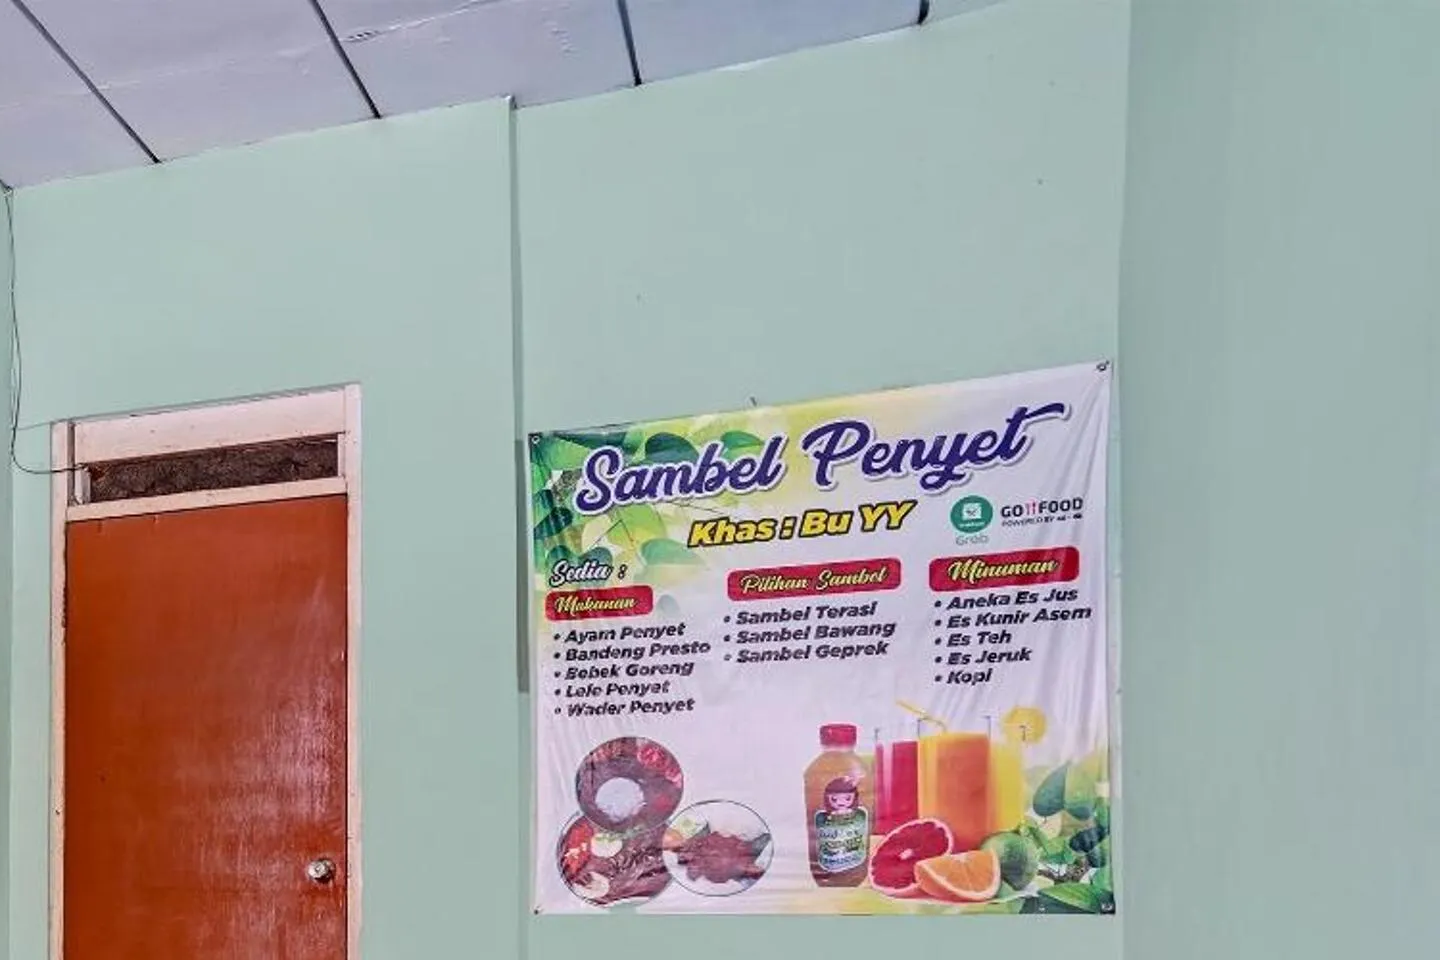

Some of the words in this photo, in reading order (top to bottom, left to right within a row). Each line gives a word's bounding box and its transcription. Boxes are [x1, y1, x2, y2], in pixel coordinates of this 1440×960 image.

[575, 434, 784, 513] Sambel
[800, 402, 1066, 491] Penyet
[687, 517, 775, 548] Khas
[799, 508, 853, 537] Bu
[858, 499, 918, 530] YY
[549, 560, 612, 587] Sedia
[740, 574, 809, 594] Pilihan
[816, 566, 889, 590] Sambel
[948, 559, 1057, 585] Minuman
[554, 595, 636, 616] Makanan
[946, 593, 1011, 610] Aneka
[1014, 591, 1039, 605] Es
[1043, 588, 1079, 602] Jus
[736, 606, 811, 625] Sambel
[816, 601, 878, 619] Terasi
[946, 615, 972, 629] Es
[974, 611, 1030, 627] Kunir
[1033, 607, 1092, 623] Asem
[564, 629, 617, 645] Ayam
[620, 622, 686, 640] Penyet
[736, 626, 811, 644] Sambel
[814, 623, 897, 639] Bawang
[946, 633, 972, 648] Es
[976, 629, 1012, 645] Teh
[565, 647, 645, 661] Bandeng
[648, 641, 711, 657] Presto
[736, 645, 811, 663] Sambel
[815, 641, 890, 659] Geprek
[947, 652, 972, 666] Es
[975, 647, 1032, 664] Jeruk
[564, 664, 621, 680] Bebek
[625, 662, 695, 677] Goreng
[946, 668, 994, 686] Kopi
[565, 684, 602, 698] Lele
[605, 680, 671, 697] Penyet
[568, 703, 626, 716] Wader
[629, 698, 696, 715] Penyet
